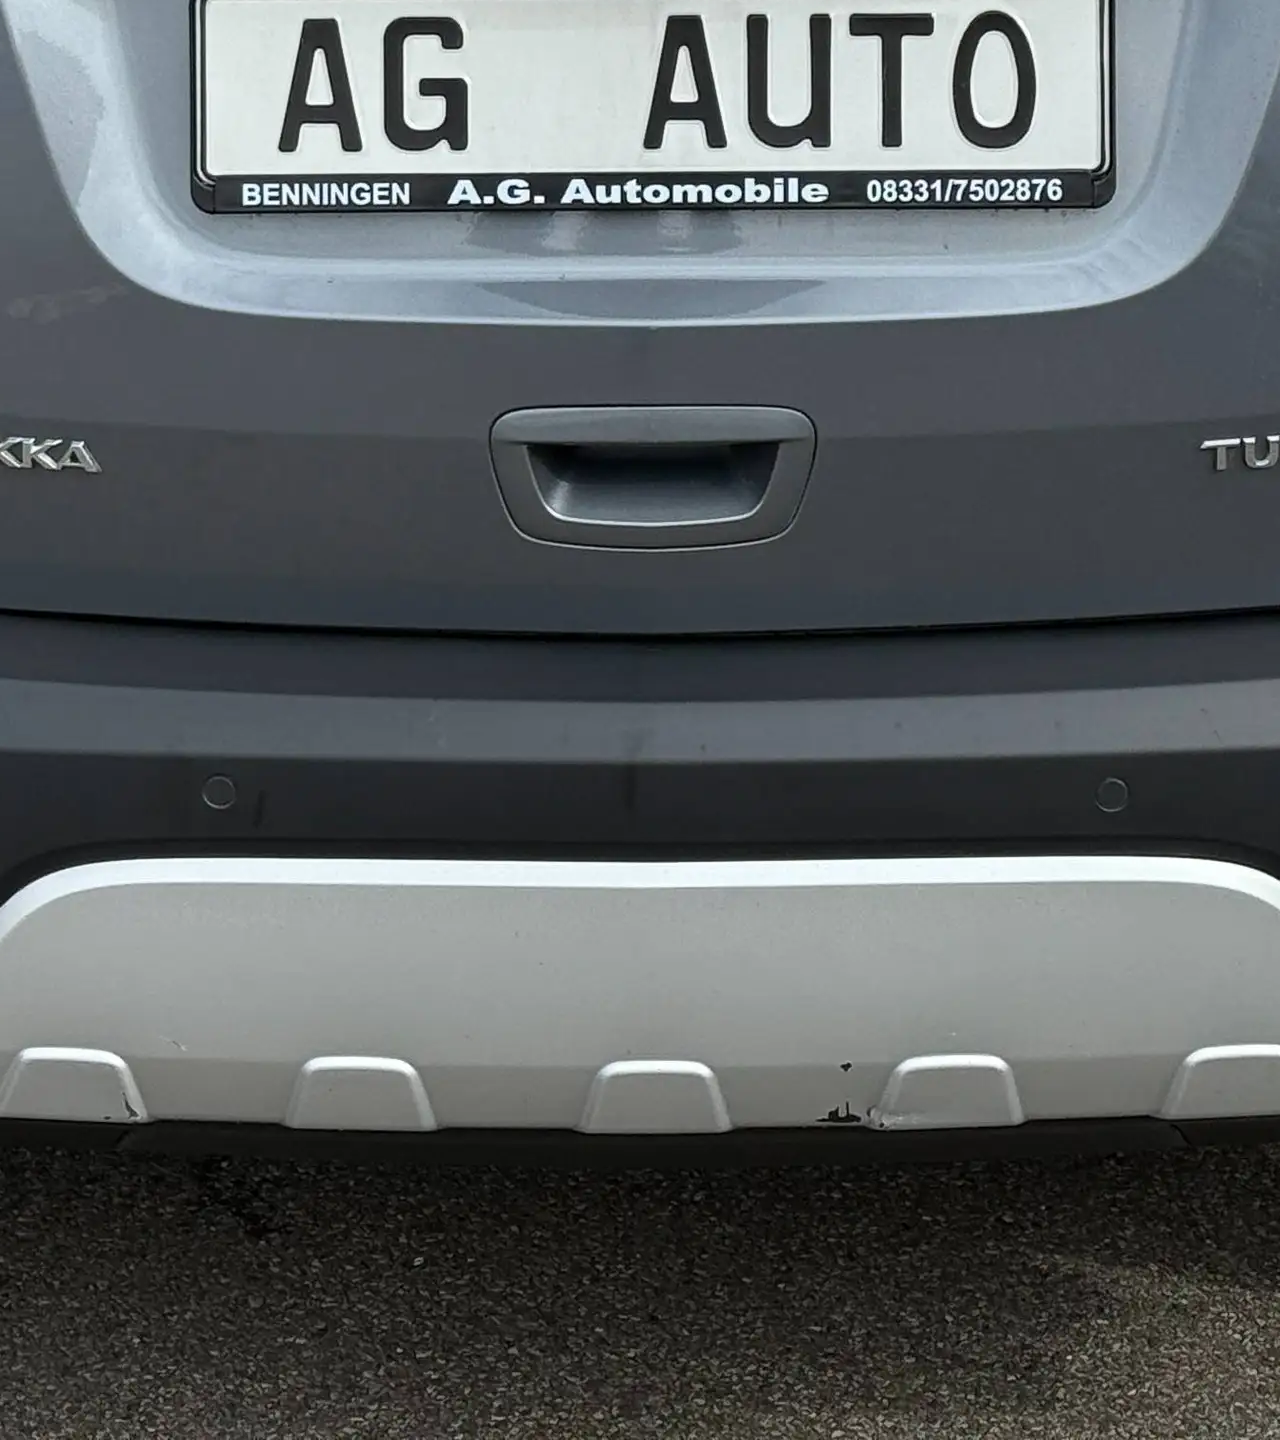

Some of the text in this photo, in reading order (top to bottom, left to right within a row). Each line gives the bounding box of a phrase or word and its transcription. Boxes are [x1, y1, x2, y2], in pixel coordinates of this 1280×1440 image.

[277, 10, 1037, 153] AG AUTO
[241, 177, 1063, 207] BENNINGEN A.G. Automobile 08331/7502876
